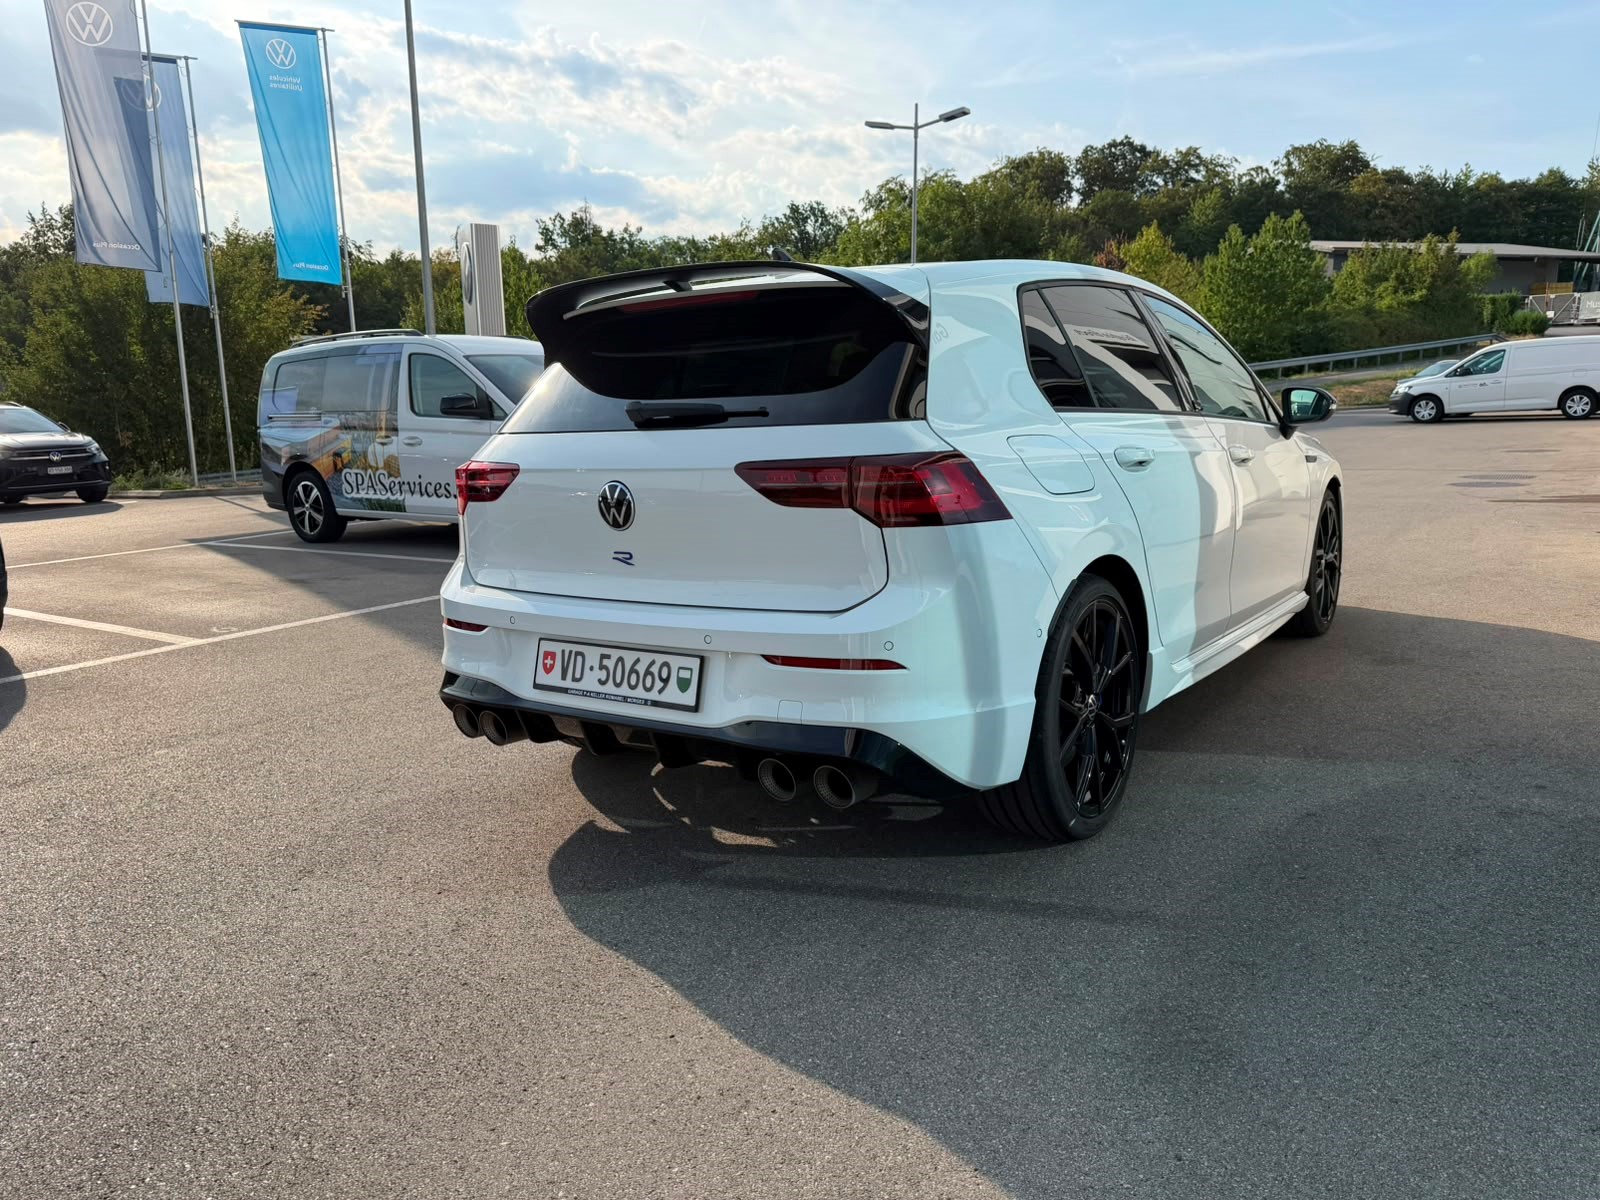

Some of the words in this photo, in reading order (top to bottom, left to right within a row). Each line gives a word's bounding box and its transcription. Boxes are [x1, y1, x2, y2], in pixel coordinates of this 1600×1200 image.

[66, 1, 113, 46] VW
[266, 39, 296, 69] VW
[598, 480, 635, 531] VW
[612, 551, 635, 566] R
